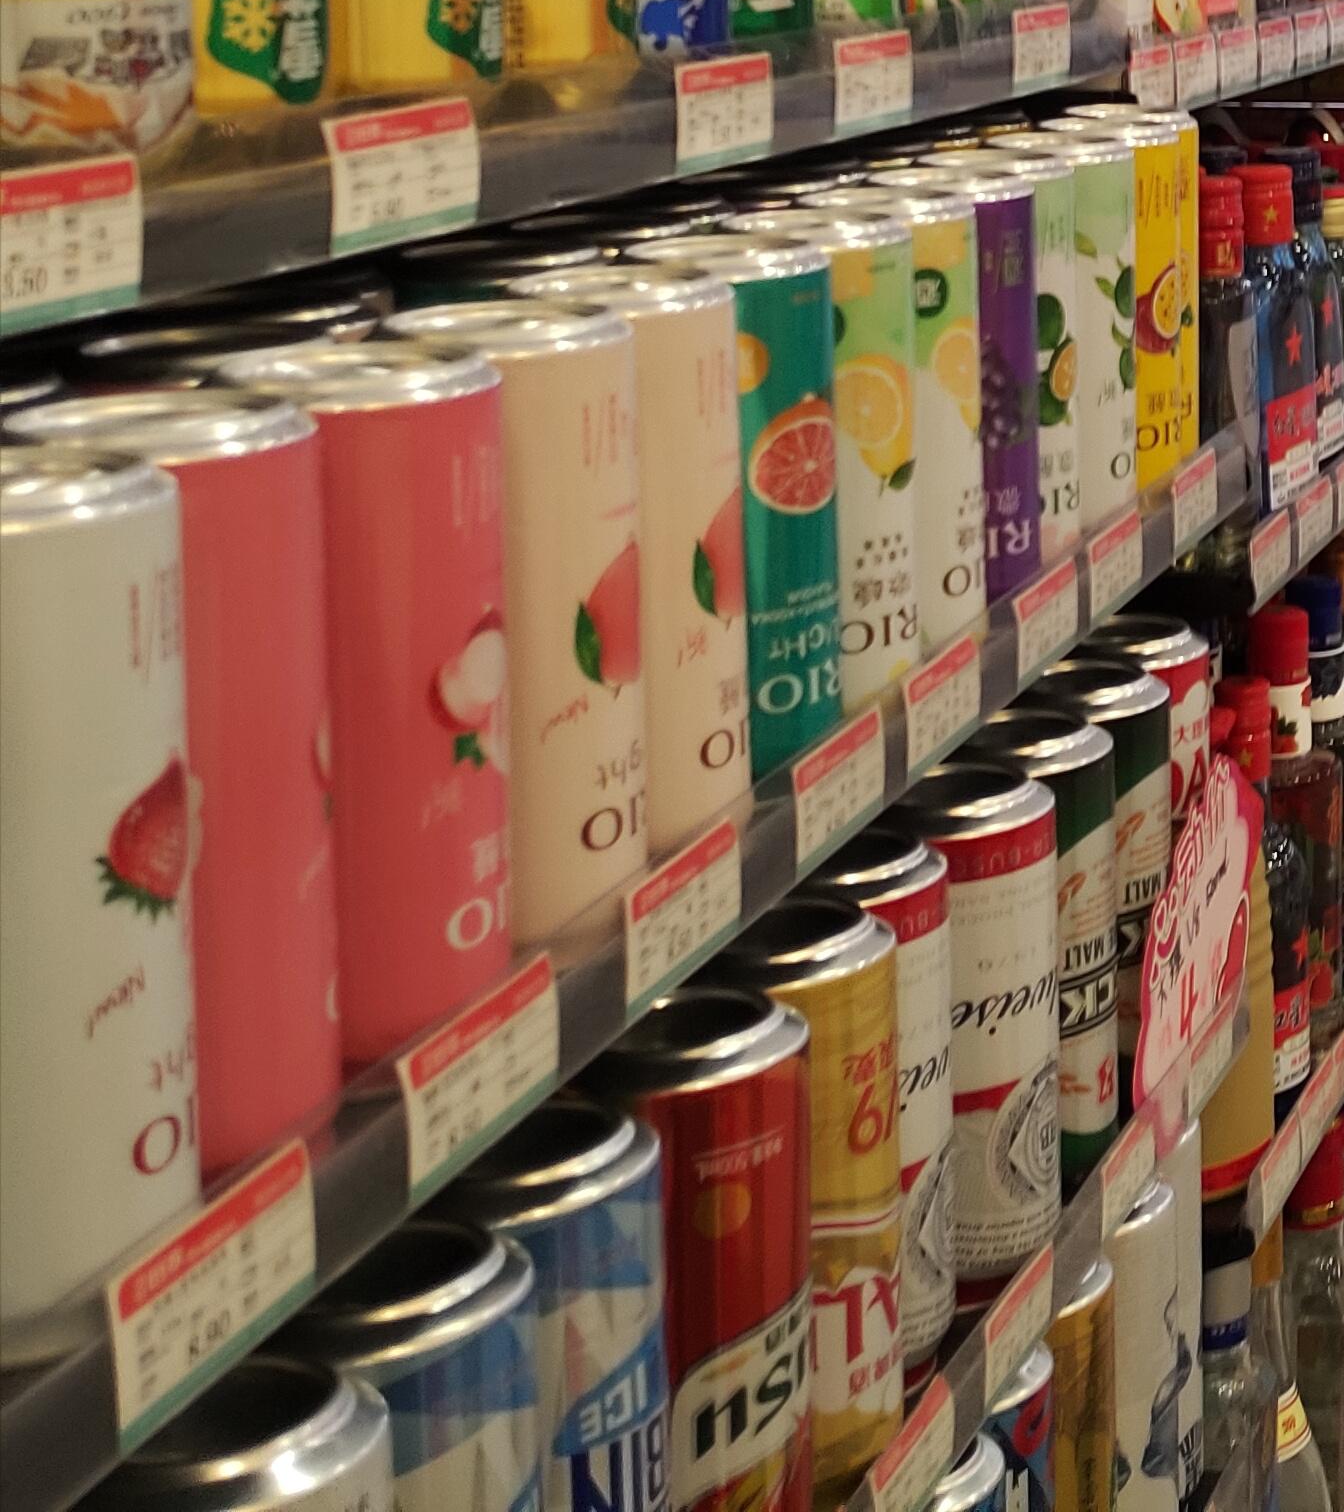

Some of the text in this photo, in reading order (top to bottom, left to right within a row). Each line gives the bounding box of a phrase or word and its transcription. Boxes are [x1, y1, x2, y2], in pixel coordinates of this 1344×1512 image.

[987, 519, 1031, 559] RI
[950, 968, 1058, 1037] weise
[578, 1368, 647, 1445] ICE
